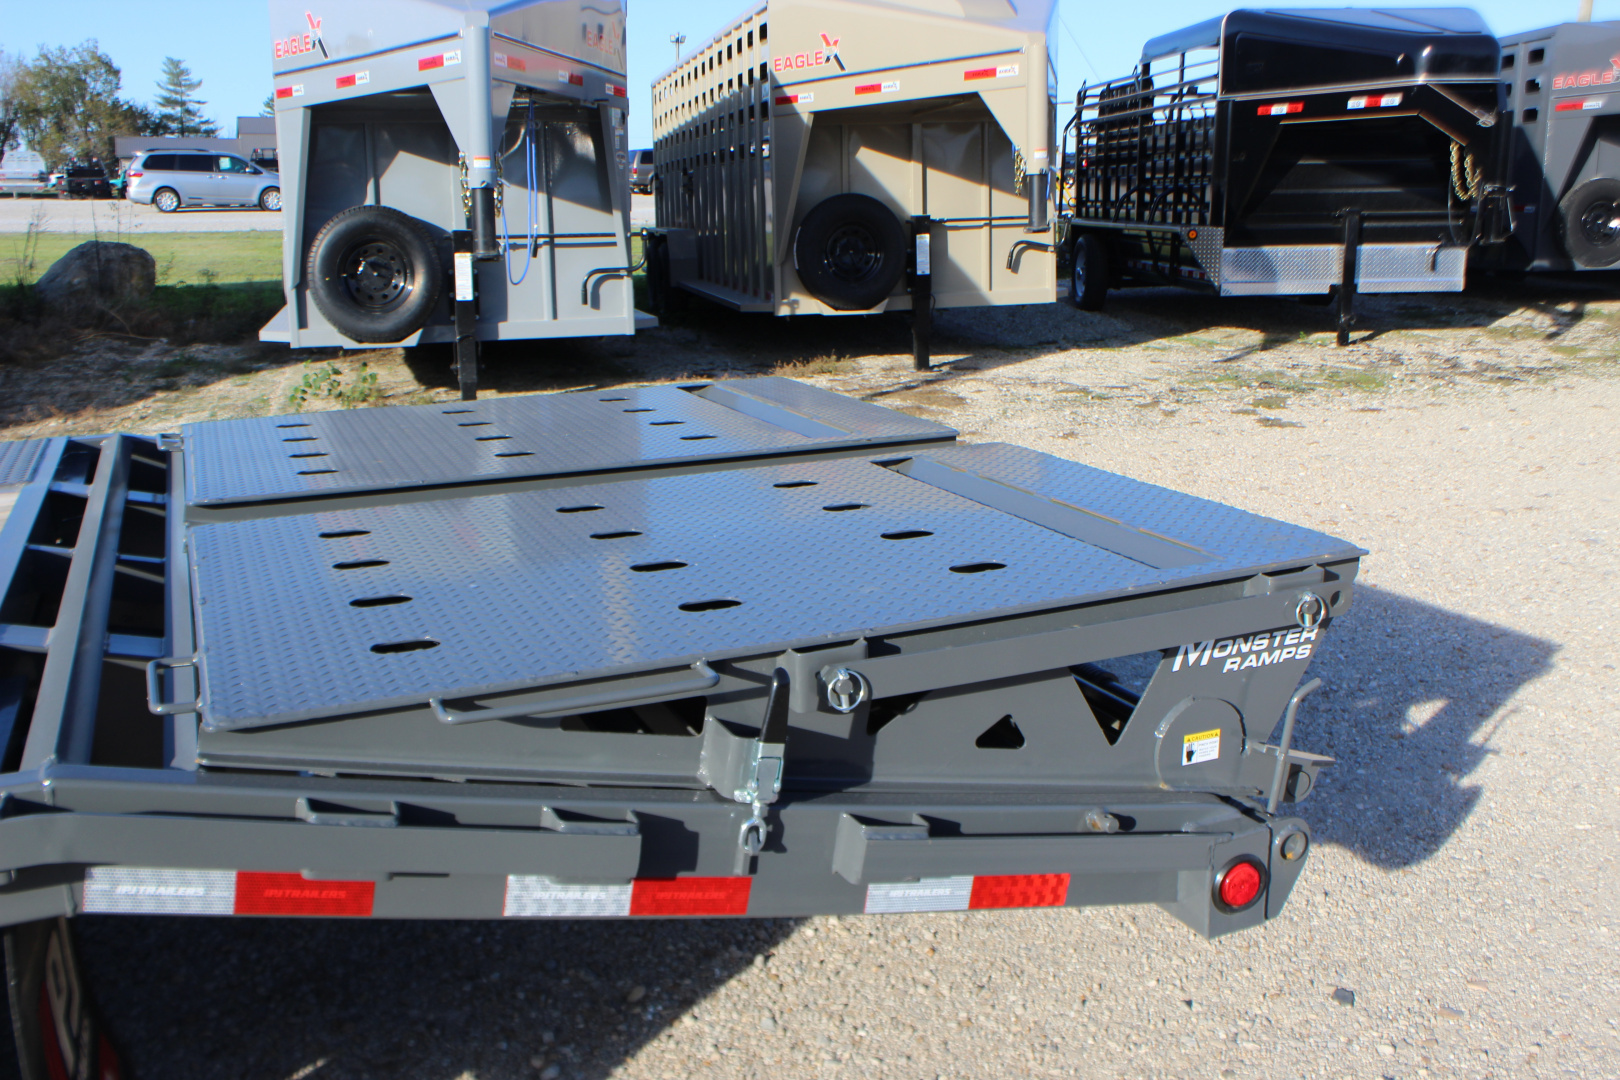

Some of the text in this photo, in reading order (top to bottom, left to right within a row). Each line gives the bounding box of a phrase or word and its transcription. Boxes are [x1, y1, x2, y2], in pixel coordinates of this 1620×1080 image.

[1171, 624, 1319, 672] MONSTER
[1222, 643, 1313, 673] RAMPS
[1191, 733, 1214, 742] CAUTION
